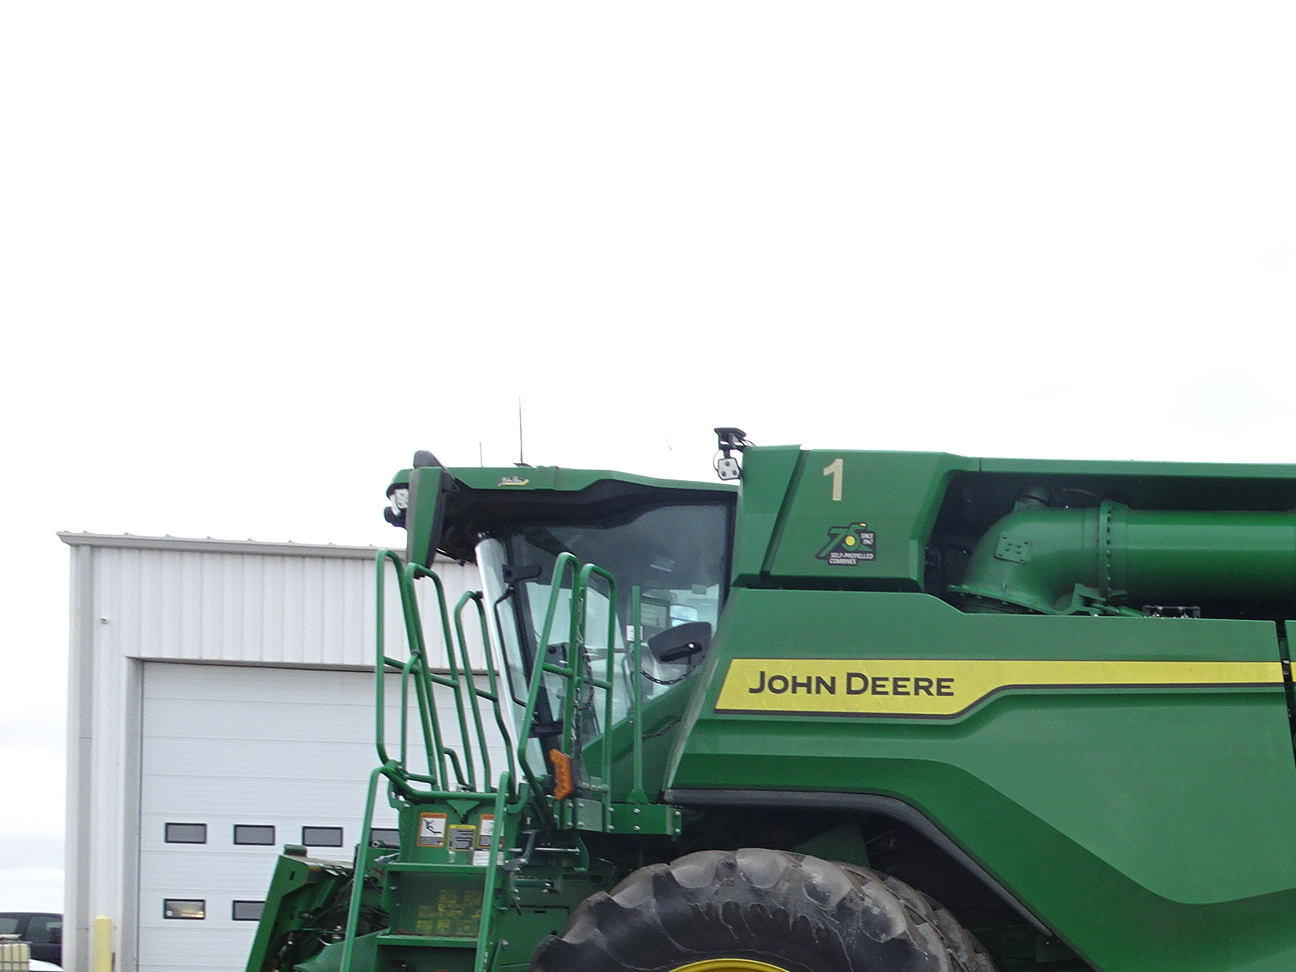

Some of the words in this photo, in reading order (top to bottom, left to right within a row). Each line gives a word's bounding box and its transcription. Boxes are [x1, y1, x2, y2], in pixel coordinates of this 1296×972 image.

[822, 457, 844, 502] 1
[748, 670, 837, 696] JOHN
[845, 672, 955, 697] DEERE
